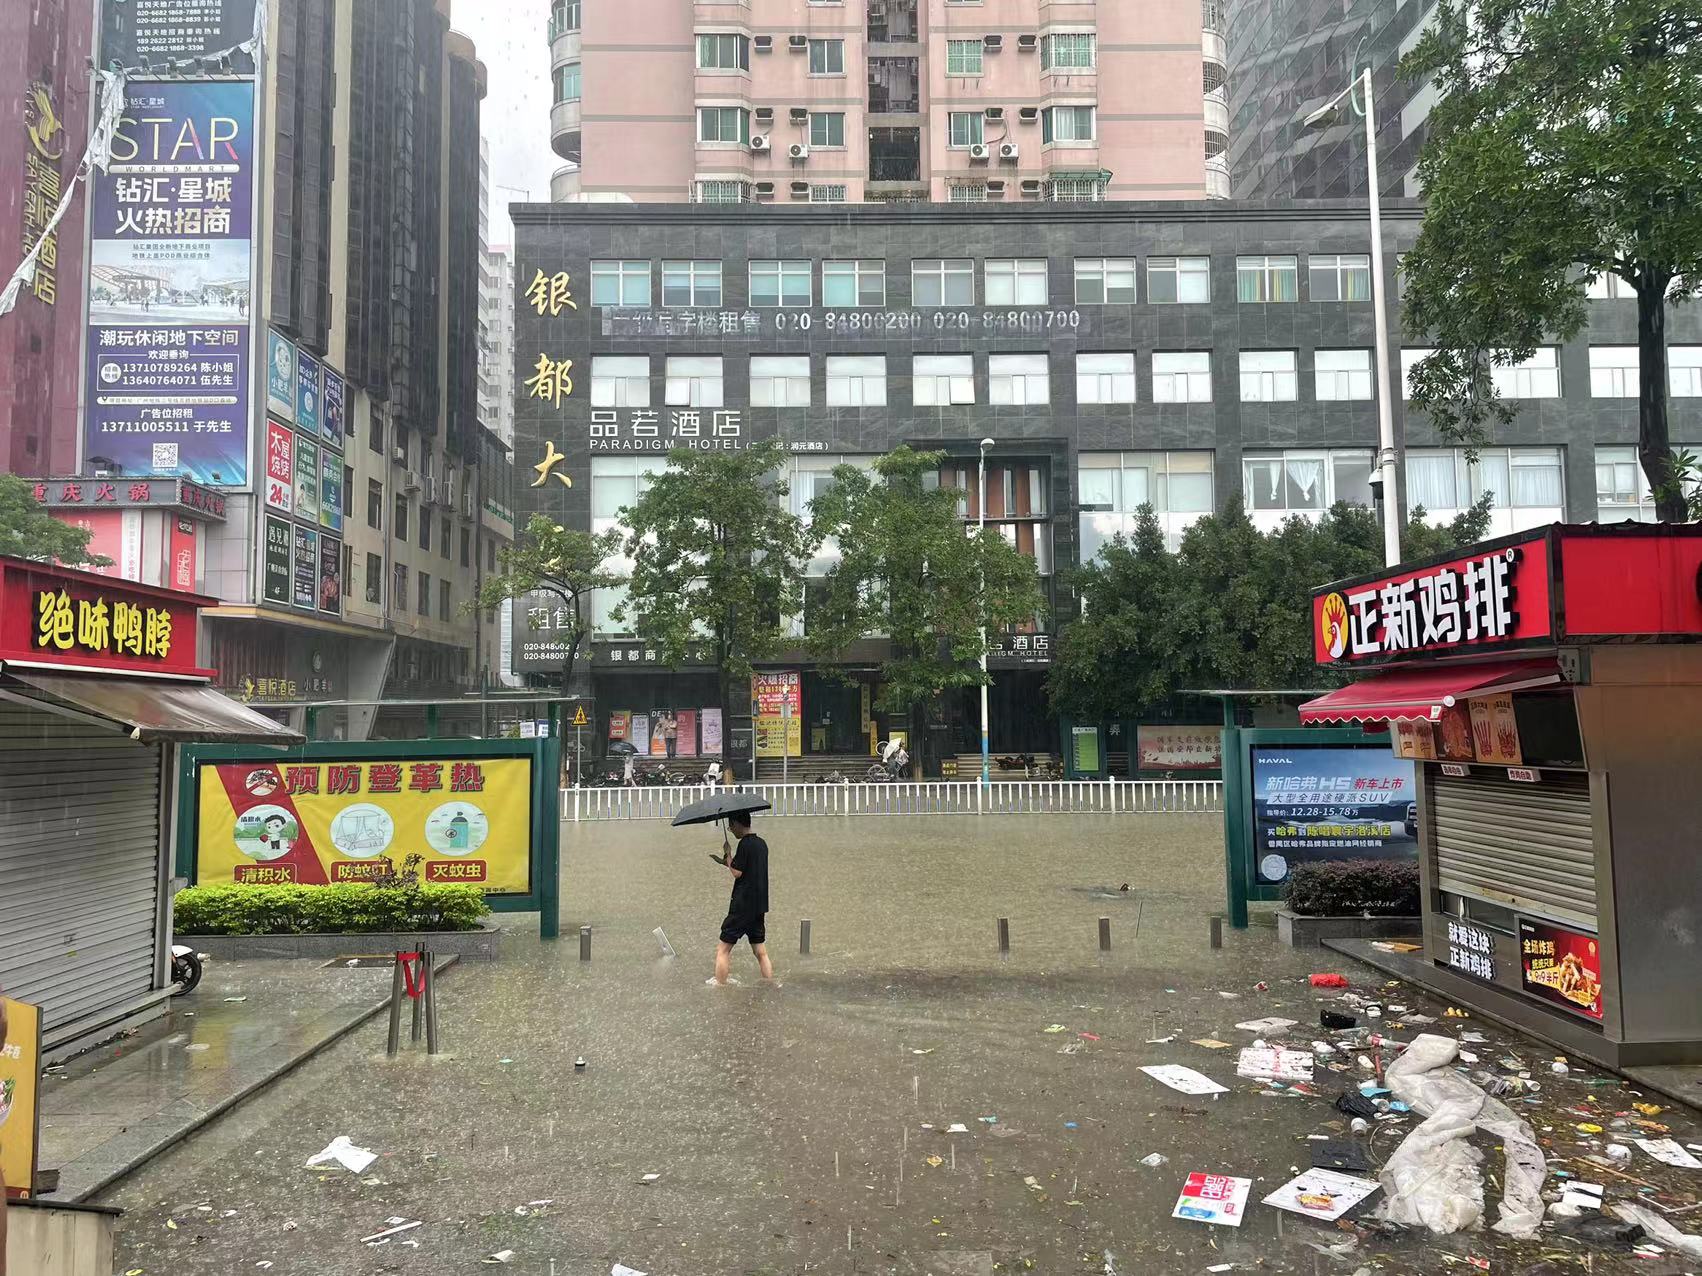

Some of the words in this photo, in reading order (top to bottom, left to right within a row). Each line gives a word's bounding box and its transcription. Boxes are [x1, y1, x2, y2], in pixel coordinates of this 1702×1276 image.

[110, 117, 239, 161] STAR
[125, 165, 226, 173] WORLDMART
[115, 177, 232, 203] 钻汇·星城
[115, 205, 231, 234] 火热招商
[99, 330, 239, 346] 潮玩休闲地下空间
[148, 350, 189, 360] 欢迎垂询
[123, 363, 197, 373] 13710789264
[200, 362, 234, 373] 陈小姐
[122, 375, 197, 385] 13640764071
[200, 374, 233, 386] 伍先生
[140, 408, 193, 419] 广告位招租
[102, 421, 189, 432] 13711005511
[193, 420, 232, 433] 于先生
[590, 410, 741, 437] 品若酒店
[590, 439, 675, 450] PARADIGM
[689, 439, 742, 450] HOTEL
[33, 483, 150, 502] 重庆火锅
[269, 484, 284, 504] 24
[1349, 555, 1511, 655] 正新鸡排
[38, 588, 172, 658] 绝味鸭脖
[528, 606, 575, 630] 租售
[257, 678, 296, 696] 喜悦酒店
[285, 763, 485, 795] 预防登革热
[1353, 777, 1404, 790] 新车上市
[1272, 793, 1389, 804] 大型全用途硬派SUV
[241, 867, 291, 882] 清积水
[337, 864, 389, 879] 防蚊叮
[432, 864, 482, 878] 灭蚊虫
[1448, 921, 1490, 955] 就爱这块
[1523, 938, 1556, 957] 全场炸鸡
[1450, 945, 1492, 981] 正新鸡排
